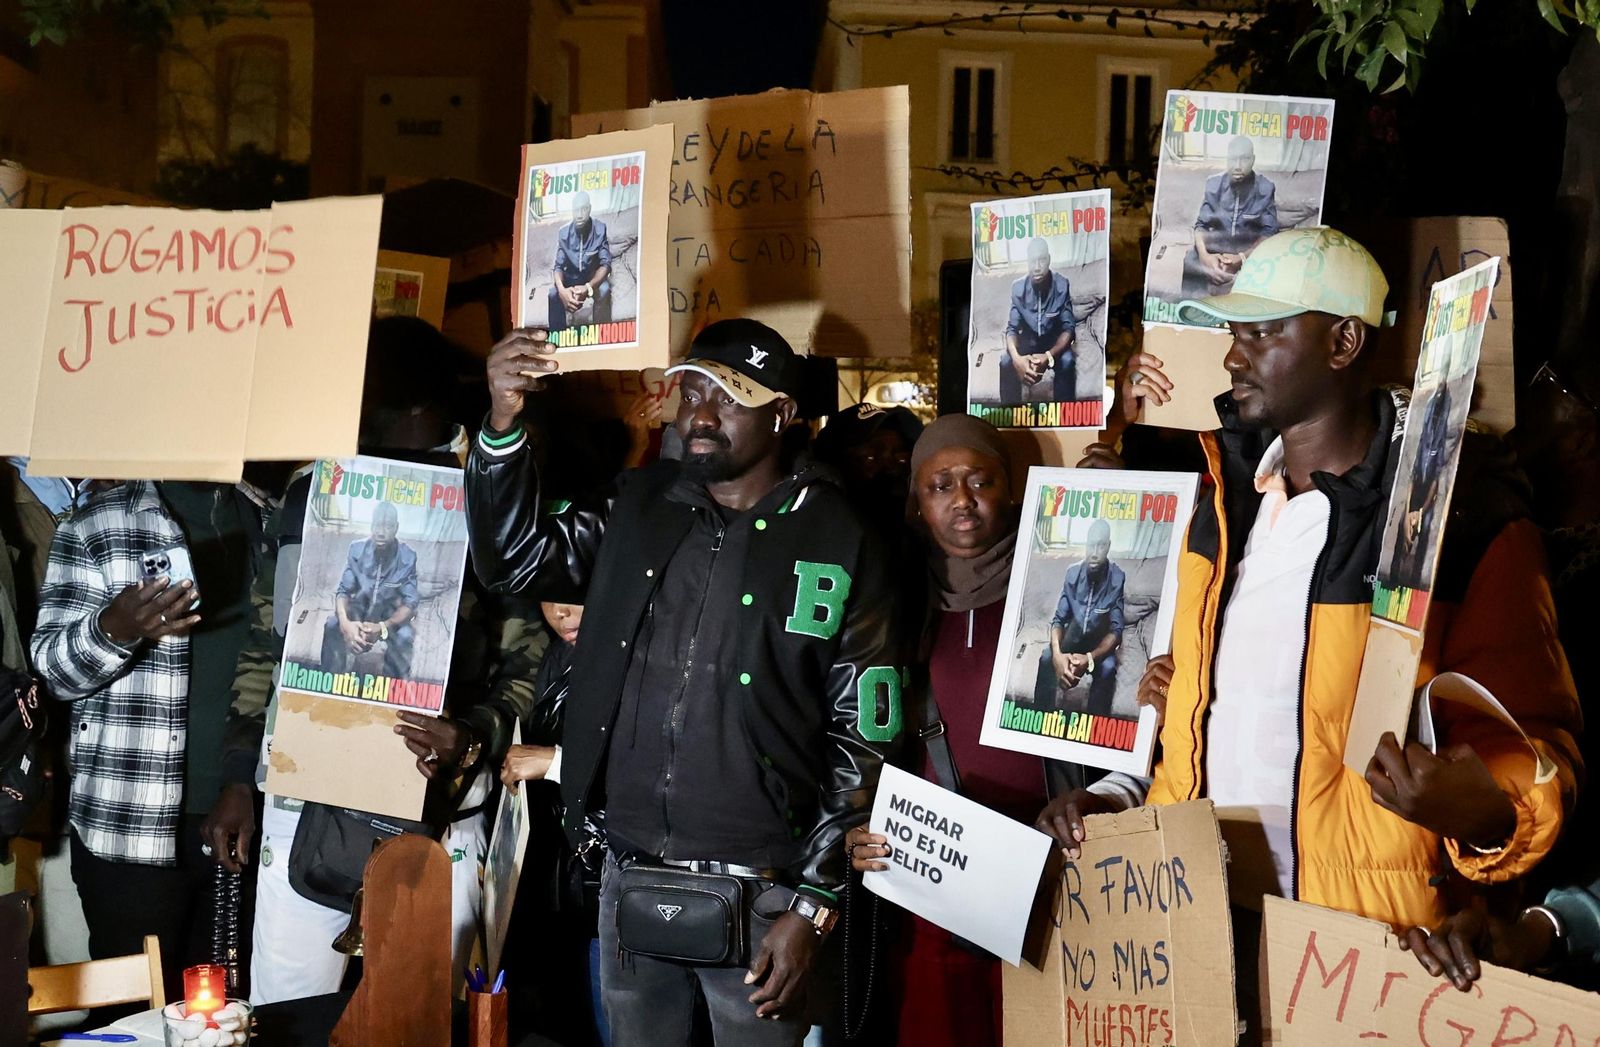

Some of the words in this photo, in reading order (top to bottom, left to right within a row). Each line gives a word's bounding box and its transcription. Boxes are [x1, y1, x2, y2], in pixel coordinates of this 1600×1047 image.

[1193, 108, 1282, 138] JUSTICIA
[1286, 113, 1329, 141] POR
[672, 122, 730, 175] EY
[736, 129, 771, 162] DE
[549, 168, 609, 195] JUSTICIA
[611, 165, 640, 188] POR
[670, 169, 826, 210] RANGERIA
[996, 210, 1070, 240] JUSTICIA
[1072, 207, 1106, 234] POR
[61, 223, 296, 280] ROGAMOS
[671, 237, 712, 267] TA
[729, 233, 823, 267] CADA
[339, 470, 426, 507] JUSTICIA
[1060, 489, 1138, 521] JUSTICIA
[1139, 493, 1179, 523] POR
[785, 560, 852, 640] B
[282, 661, 361, 697] Mamouth
[857, 666, 902, 742] O
[1000, 700, 1067, 738] Mamouth
[889, 793, 964, 841] MIGRAR
[884, 817, 913, 843] NO
[916, 833, 937, 854] ES
[939, 844, 969, 871] UN
[1095, 855, 1193, 915] FAVOR
[1062, 939, 1096, 992] NO
[1112, 938, 1170, 996] MAS
